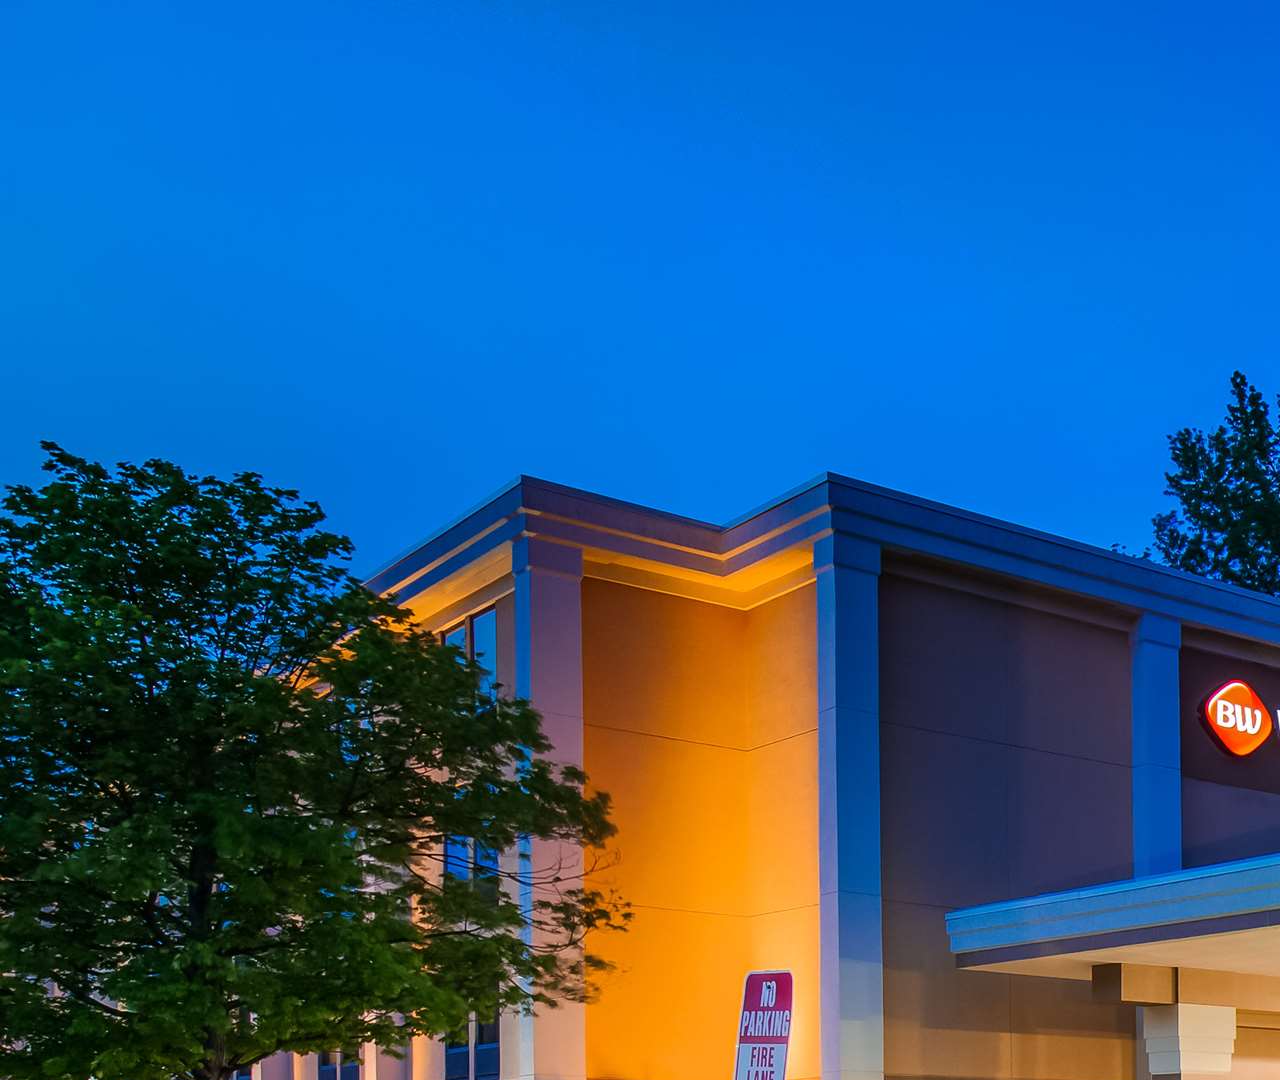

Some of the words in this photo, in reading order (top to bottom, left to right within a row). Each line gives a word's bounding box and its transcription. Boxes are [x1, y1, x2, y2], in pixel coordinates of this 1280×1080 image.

[1216, 699, 1262, 735] BW
[760, 980, 777, 1008] NO
[741, 1010, 790, 1036] PARKING
[750, 1046, 775, 1067] FIRE
